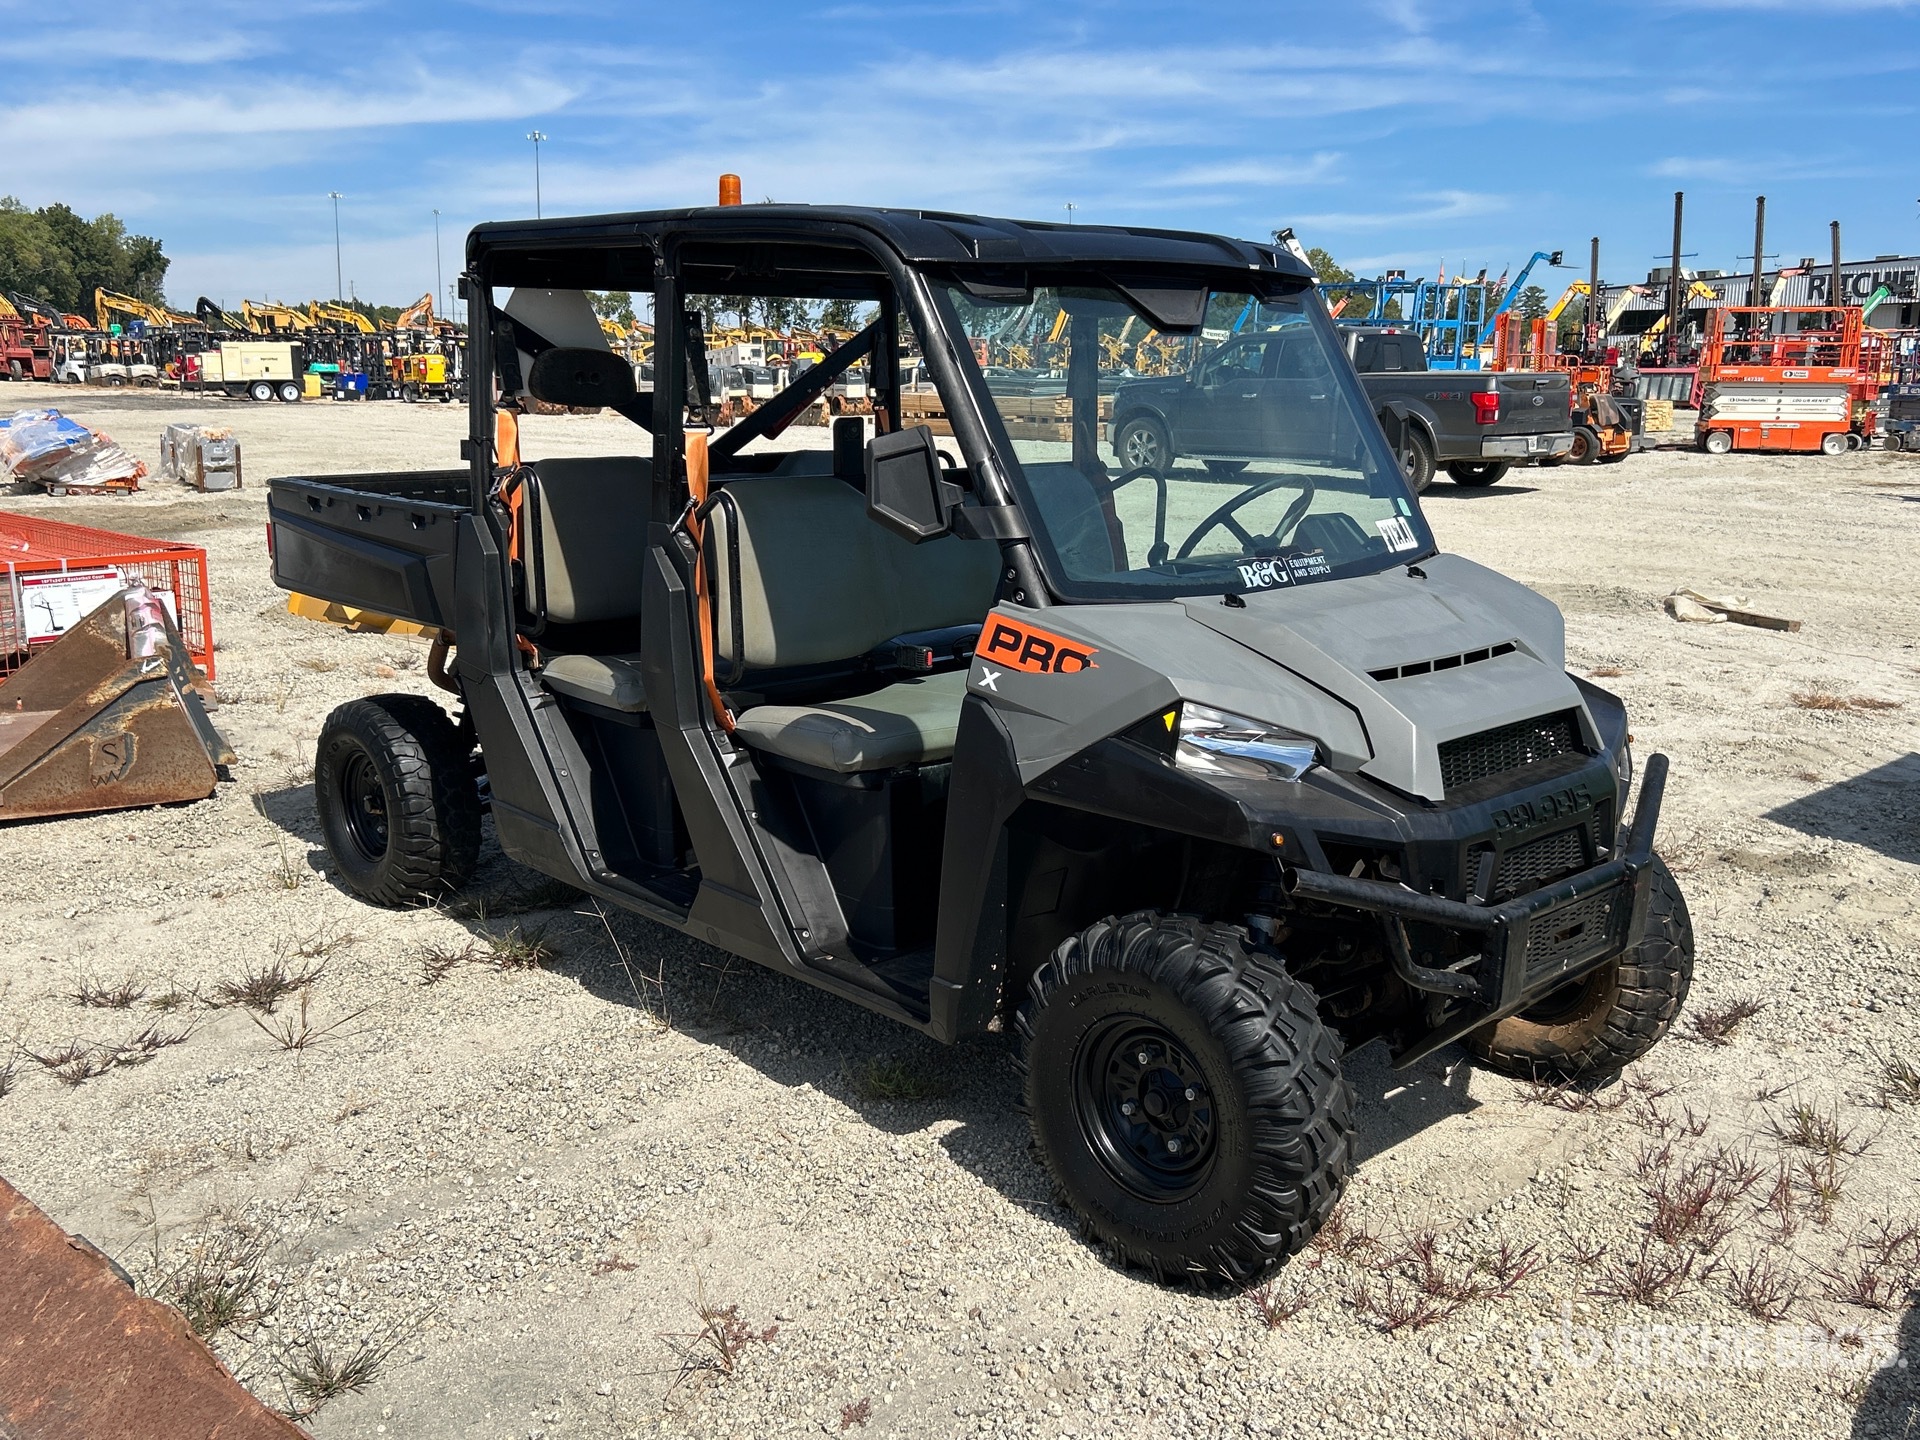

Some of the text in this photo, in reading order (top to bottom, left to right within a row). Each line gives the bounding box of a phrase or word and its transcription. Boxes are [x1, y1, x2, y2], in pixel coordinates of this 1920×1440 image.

[1237, 558, 1290, 589] B&G
[1289, 555, 1326, 569] EQUIPMENT
[1293, 563, 1332, 578] AND SUPPLY
[987, 623, 1091, 673] PRO
[978, 666, 1002, 692] X
[1490, 783, 1593, 840] POLARIS
[1068, 982, 1152, 1009] CARLSTAR
